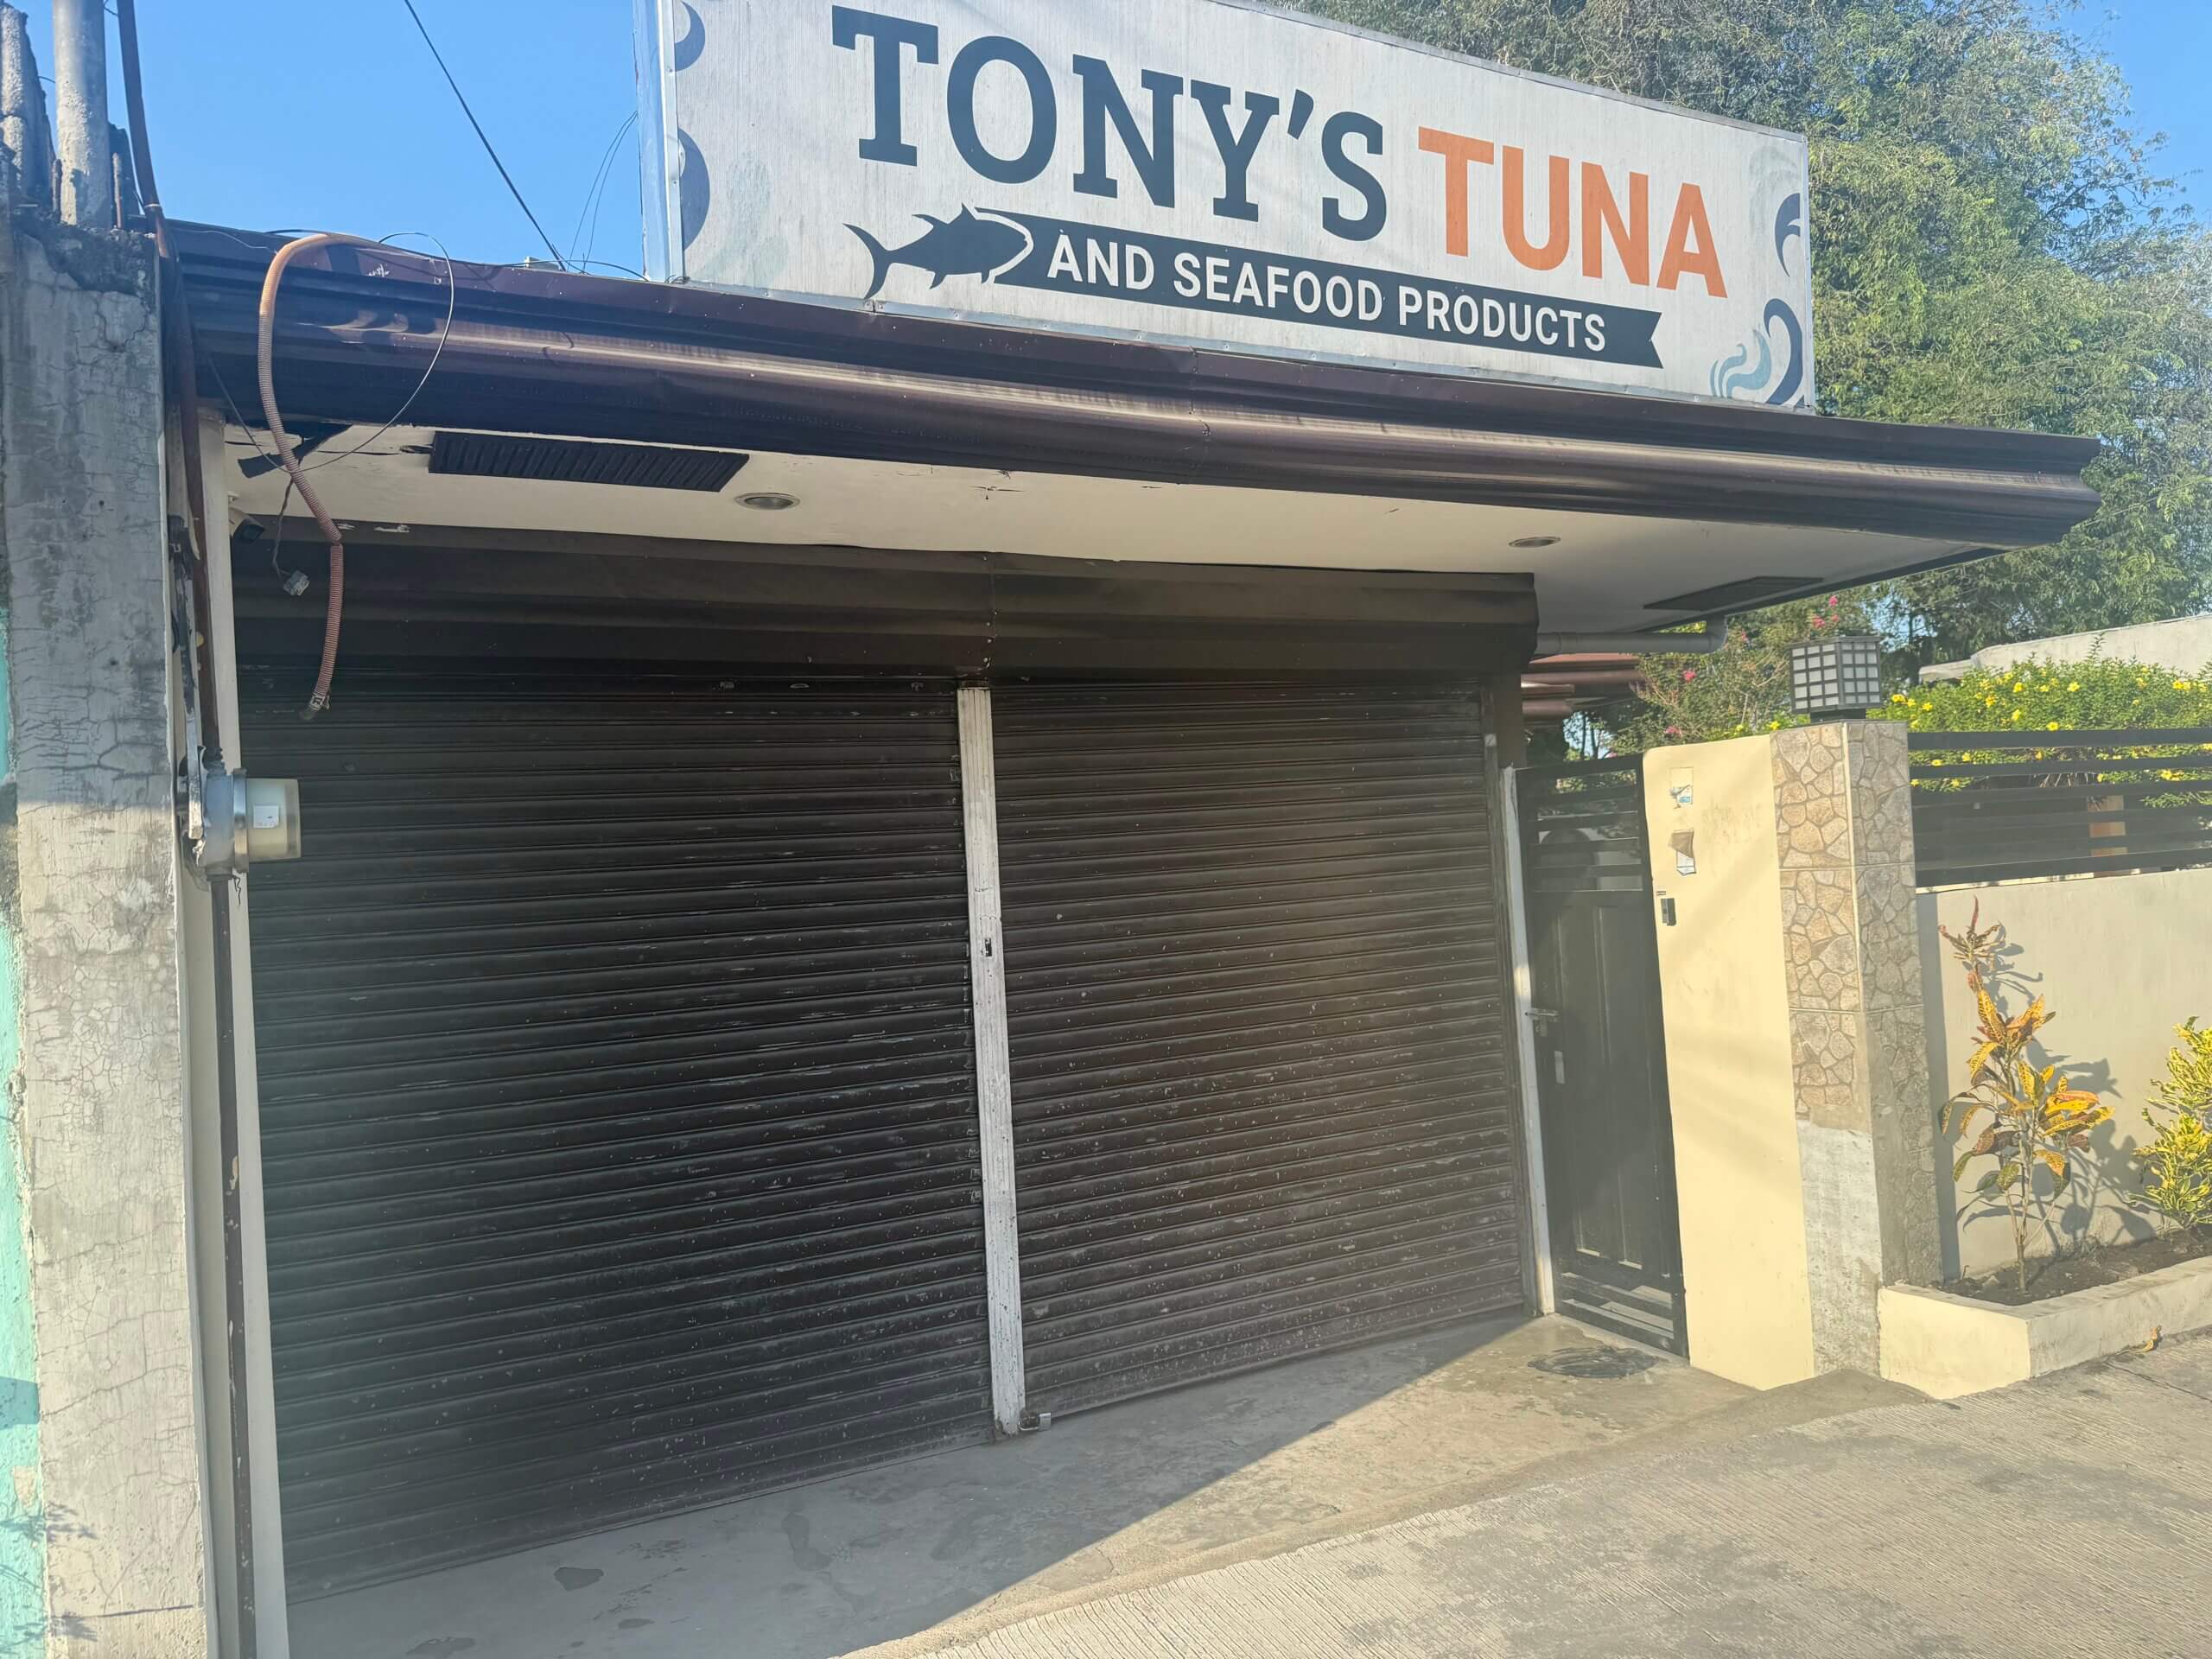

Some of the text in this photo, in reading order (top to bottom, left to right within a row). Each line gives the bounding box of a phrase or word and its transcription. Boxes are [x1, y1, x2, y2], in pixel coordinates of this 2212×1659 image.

[832, 5, 1727, 298] TONY'S TUNA
[1047, 234, 1605, 351] AND SEAFOOD PRODUCTS
